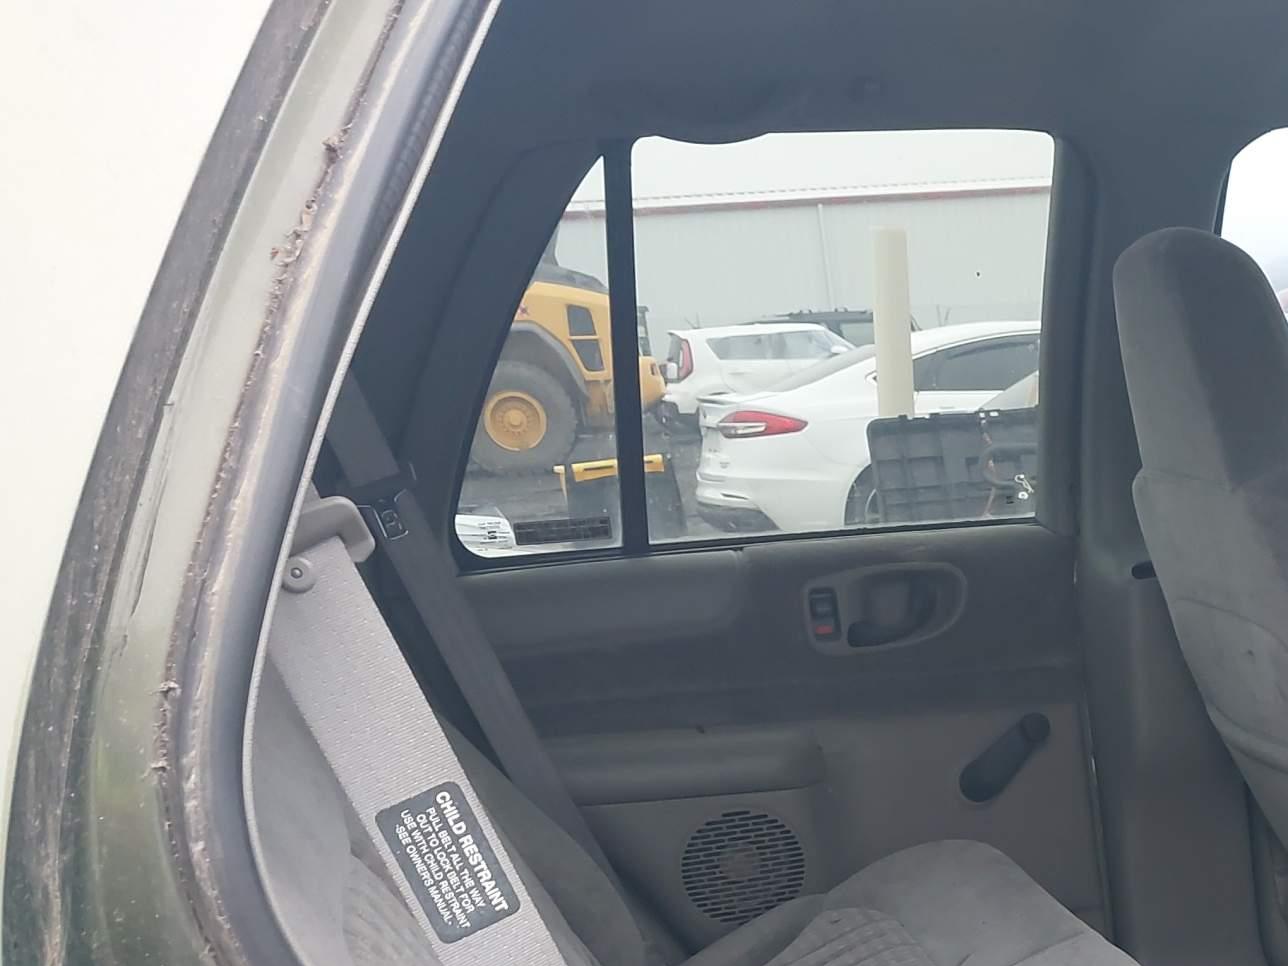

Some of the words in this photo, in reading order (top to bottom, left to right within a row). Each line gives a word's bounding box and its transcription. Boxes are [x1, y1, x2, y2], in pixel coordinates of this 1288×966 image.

[400, 809, 418, 831] USE
[410, 828, 431, 855] WITH
[423, 852, 444, 881] CHILD
[438, 879, 471, 928] RESTRAINT
[415, 813, 434, 834] OUT
[426, 832, 440, 848] TO
[433, 846, 454, 873] LOCK
[446, 870, 466, 894] BELT
[457, 892, 476, 914] FOR
[425, 806, 444, 833] PULL
[437, 829, 457, 853] BELT
[449, 853, 465, 872] ALL
[459, 867, 476, 890] THE
[468, 886, 487, 911] WAY
[435, 791, 467, 836] CHILD
[458, 833, 509, 912] RESTRAINT
